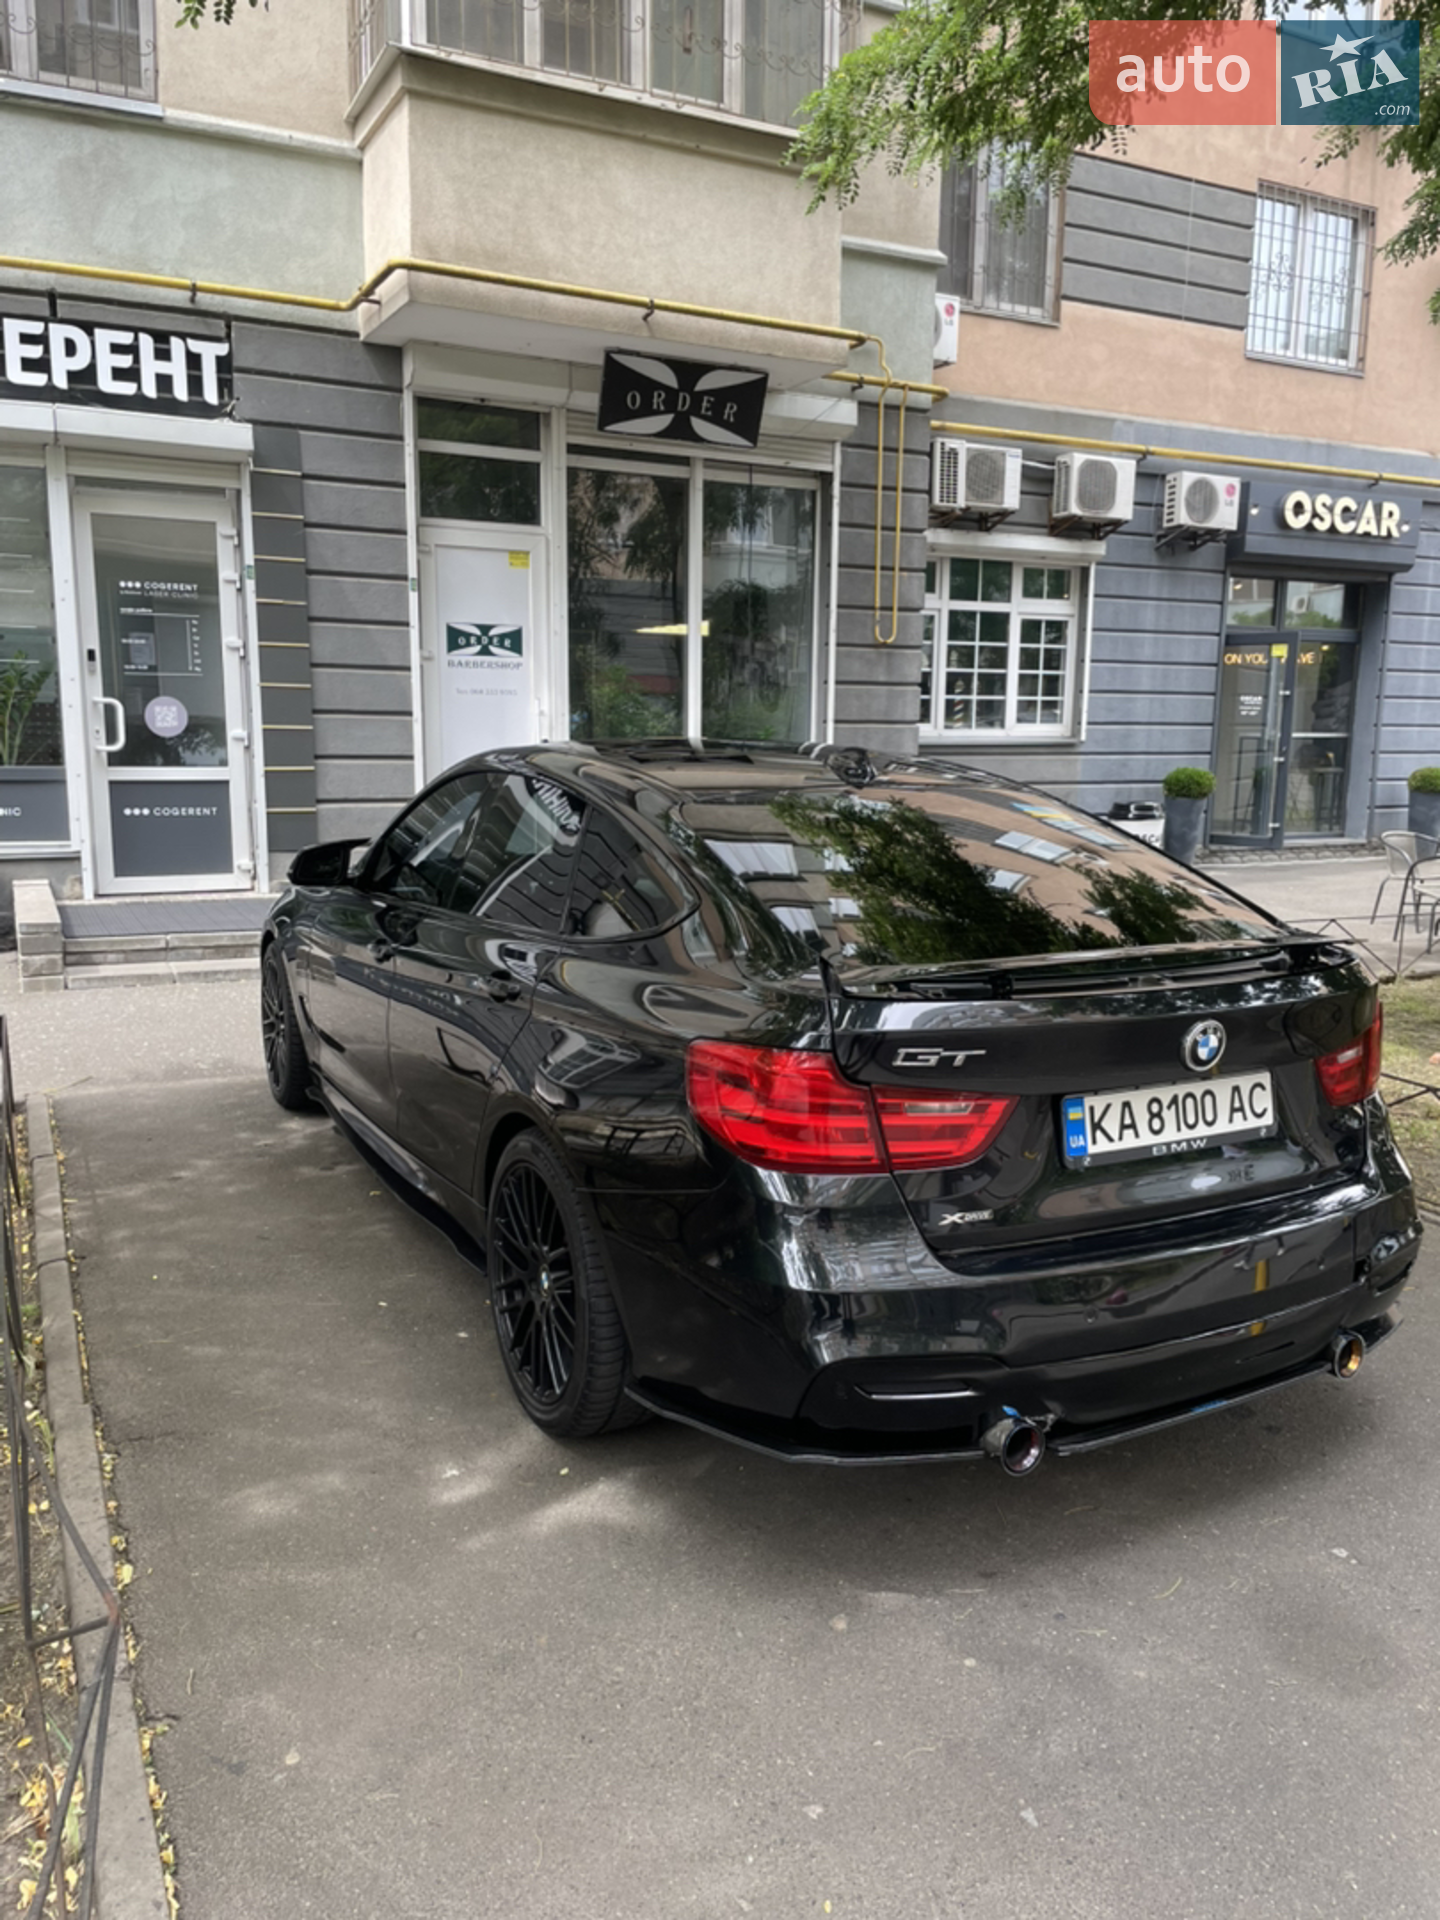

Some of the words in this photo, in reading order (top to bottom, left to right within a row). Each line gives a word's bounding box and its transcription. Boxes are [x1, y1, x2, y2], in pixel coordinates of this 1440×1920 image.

[626, 390, 738, 423] ORDER
[1283, 490, 1400, 538] OSCAR
[144, 581, 198, 591] COGERENT
[458, 635, 512, 648] ORDER
[447, 659, 524, 671] BARBERSHOP
[153, 807, 218, 817] COGERENT
[891, 1047, 987, 1067] GT
[1070, 1134, 1085, 1148] UA
[1089, 1101, 1140, 1145] KA
[1147, 1089, 1218, 1136] 8100
[1228, 1082, 1268, 1124] AC
[1152, 1138, 1208, 1156] BMW
